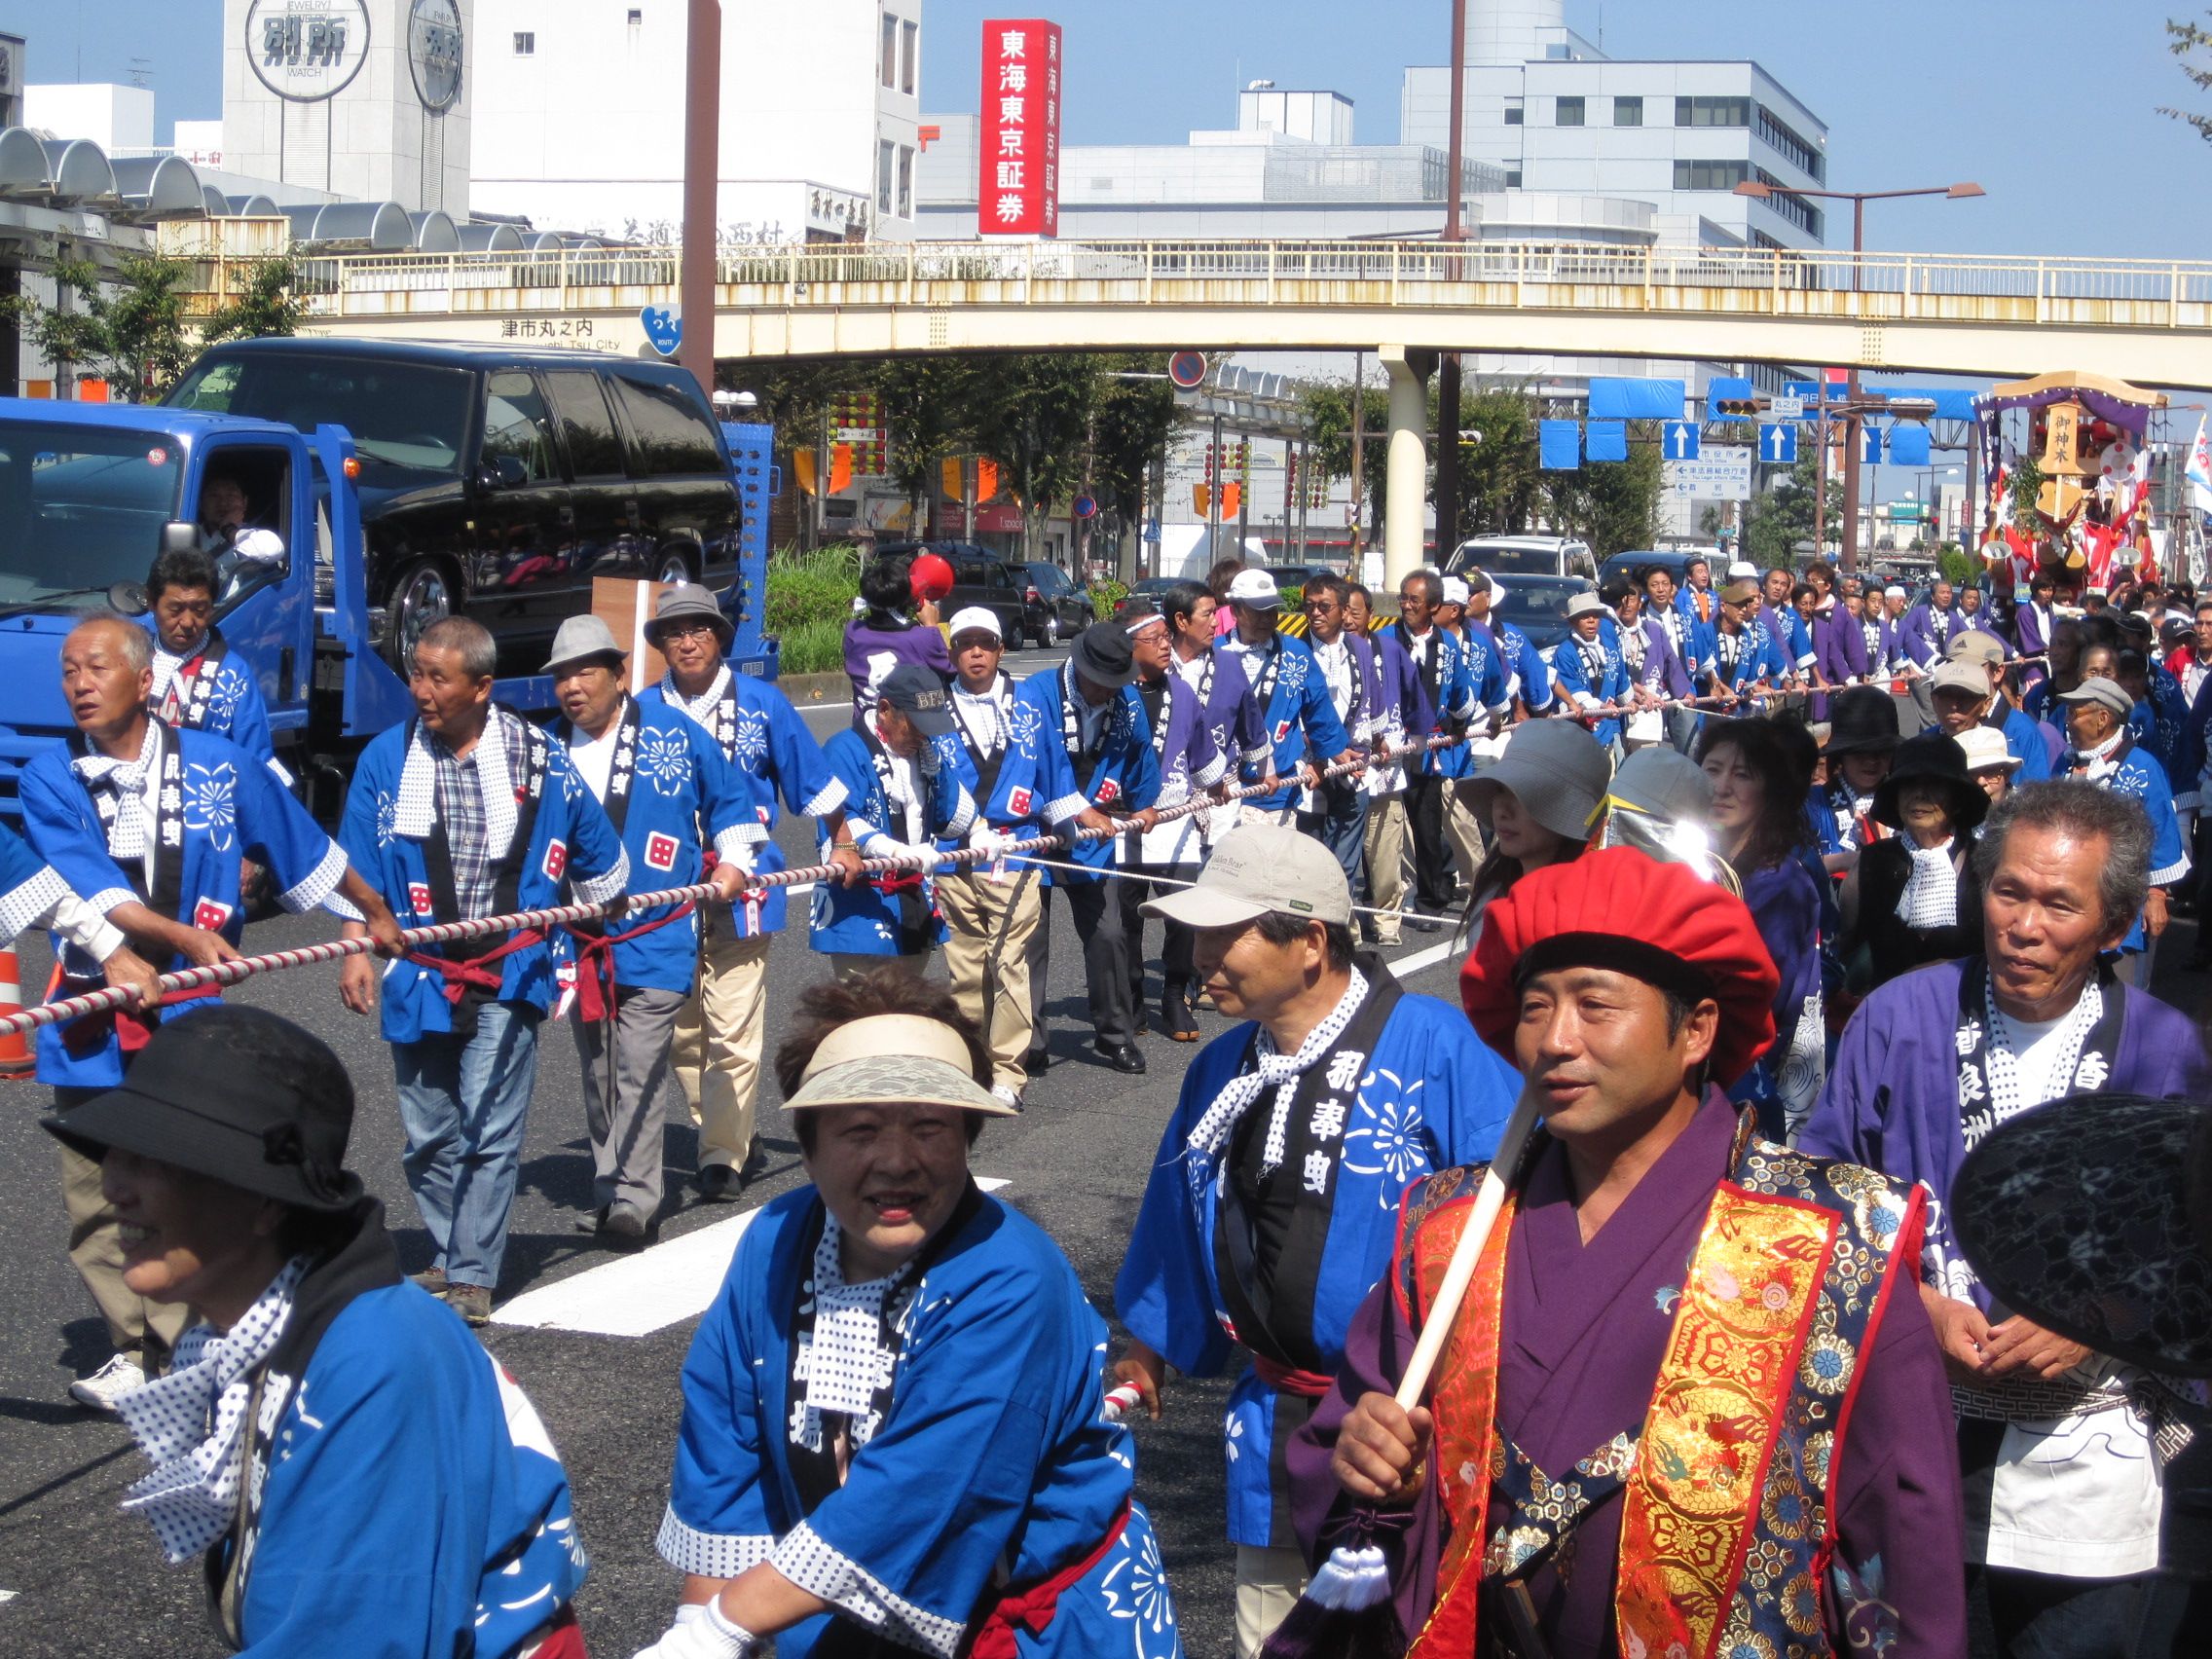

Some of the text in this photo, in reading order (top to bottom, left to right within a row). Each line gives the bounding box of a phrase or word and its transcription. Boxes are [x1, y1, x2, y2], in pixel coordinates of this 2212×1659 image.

[286, 0, 327, 10] JEWELRY
[264, 18, 346, 50] 別所
[287, 68, 321, 77] WATCH
[996, 29, 1027, 223] 東海東京証券
[1045, 33, 1057, 225] 東海東京証券
[501, 319, 593, 338] 津市丸之内
[596, 339, 620, 350] City
[2055, 415, 2071, 463] 御神木
[1152, 691, 1171, 754] 香良洲町
[1955, 1019, 1992, 1153] 香良洲
[2075, 1051, 2110, 1091] 香
[1303, 1050, 1366, 1196] 祝奉曳
